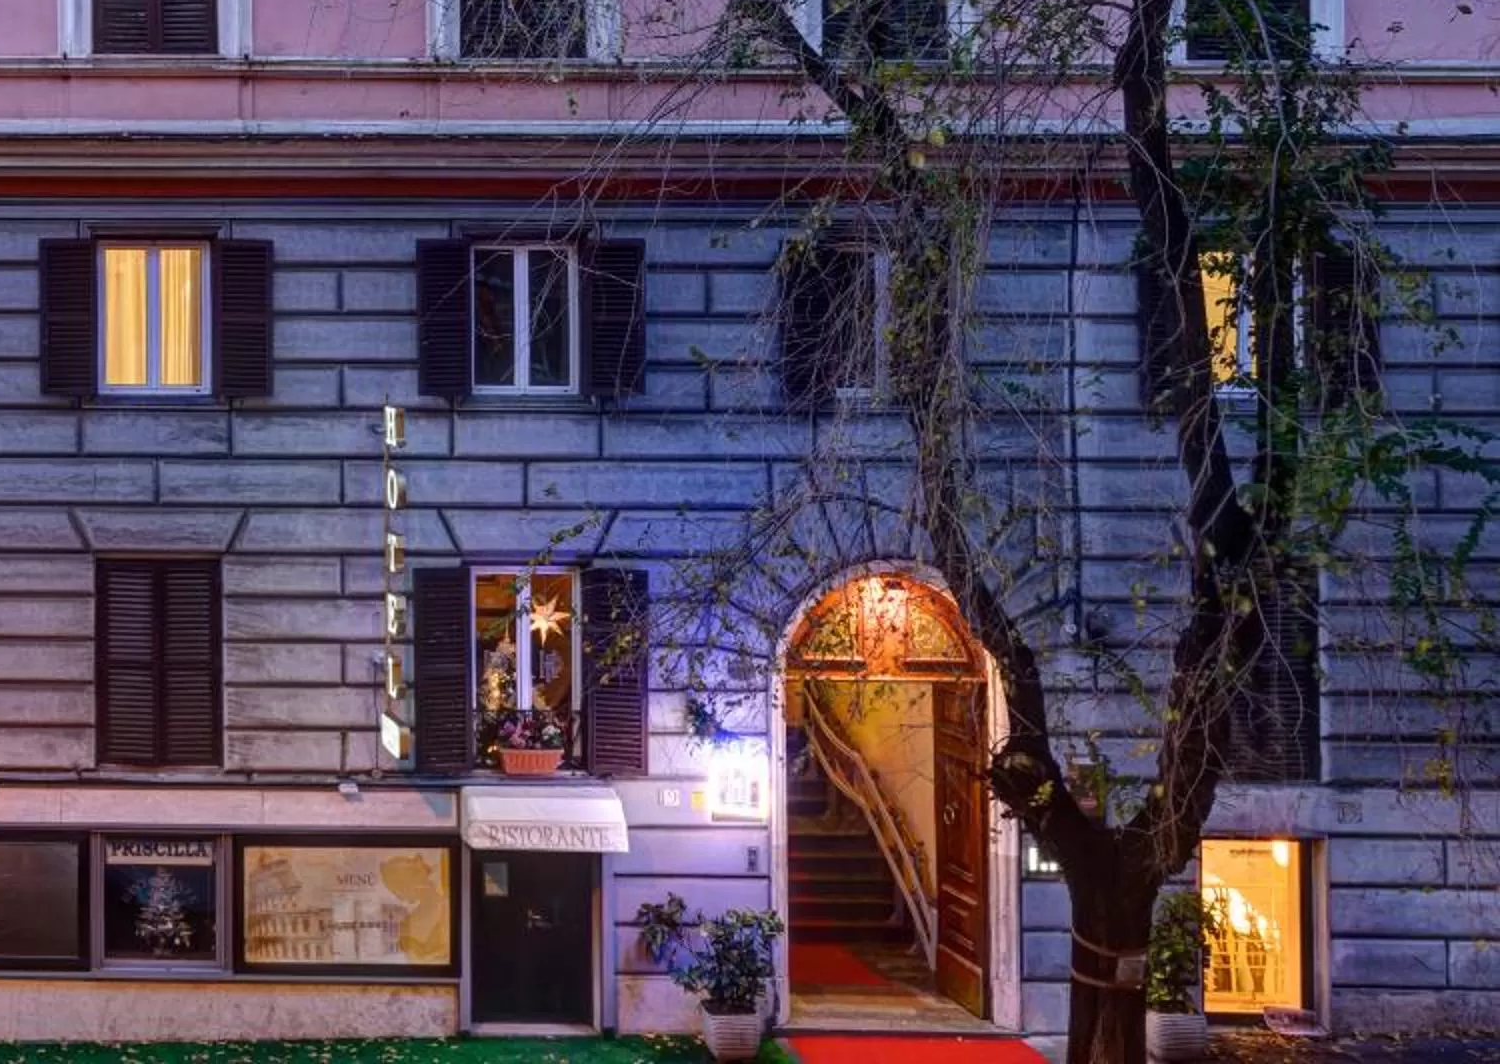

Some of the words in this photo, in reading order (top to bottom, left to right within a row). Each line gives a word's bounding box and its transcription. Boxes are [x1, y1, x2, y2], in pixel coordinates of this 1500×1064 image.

[384, 406, 399, 699] HOTEL
[489, 825, 612, 847] RISTORANTE
[110, 840, 210, 857] PRISCILLA
